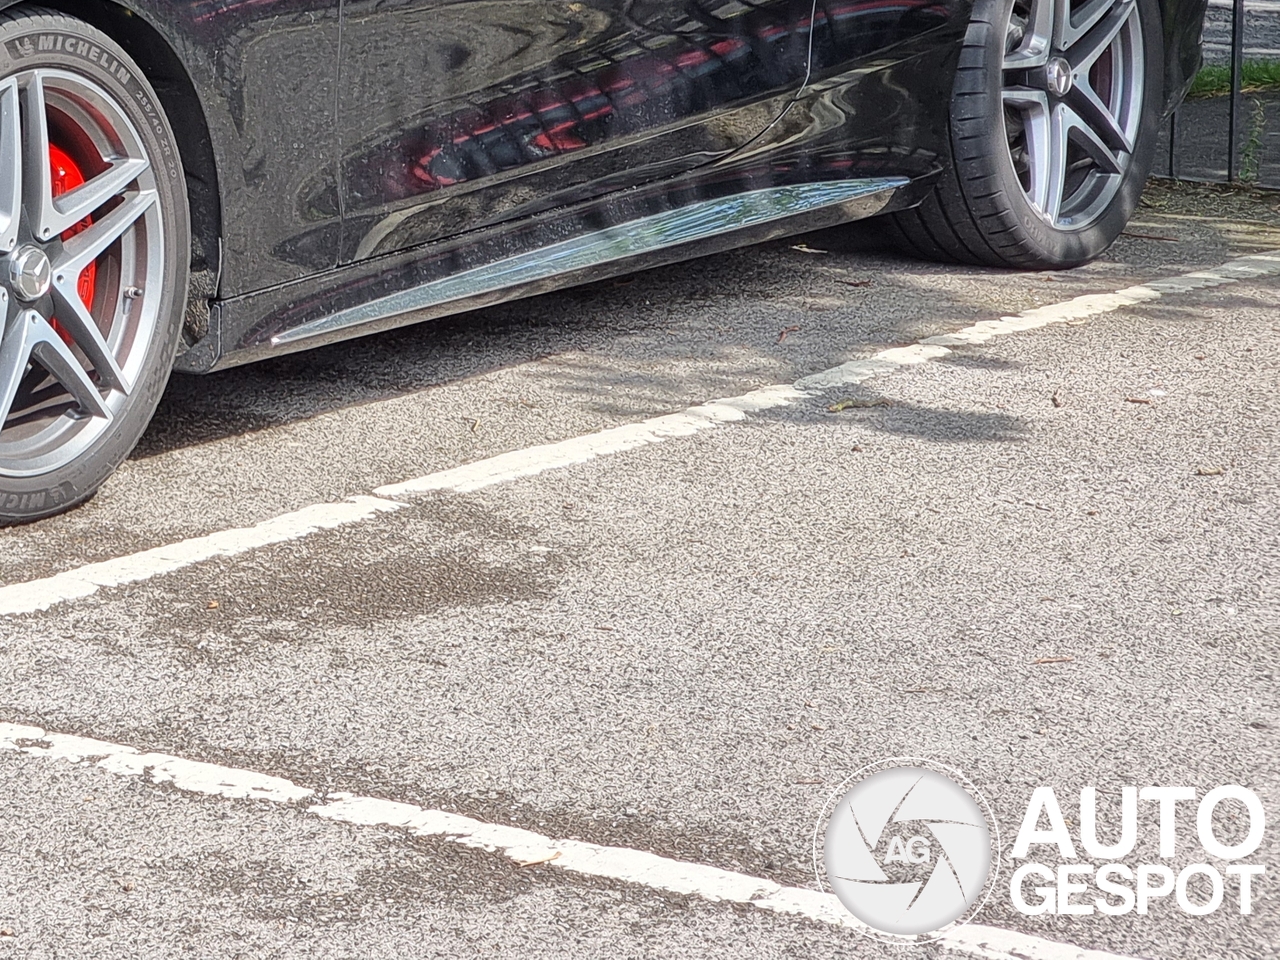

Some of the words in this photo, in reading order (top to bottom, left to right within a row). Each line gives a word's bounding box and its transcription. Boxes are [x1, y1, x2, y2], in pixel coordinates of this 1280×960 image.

[37, 34, 132, 85] MICHELIN
[135, 90, 163, 135] 255/40
[161, 137, 172, 157] ZR
